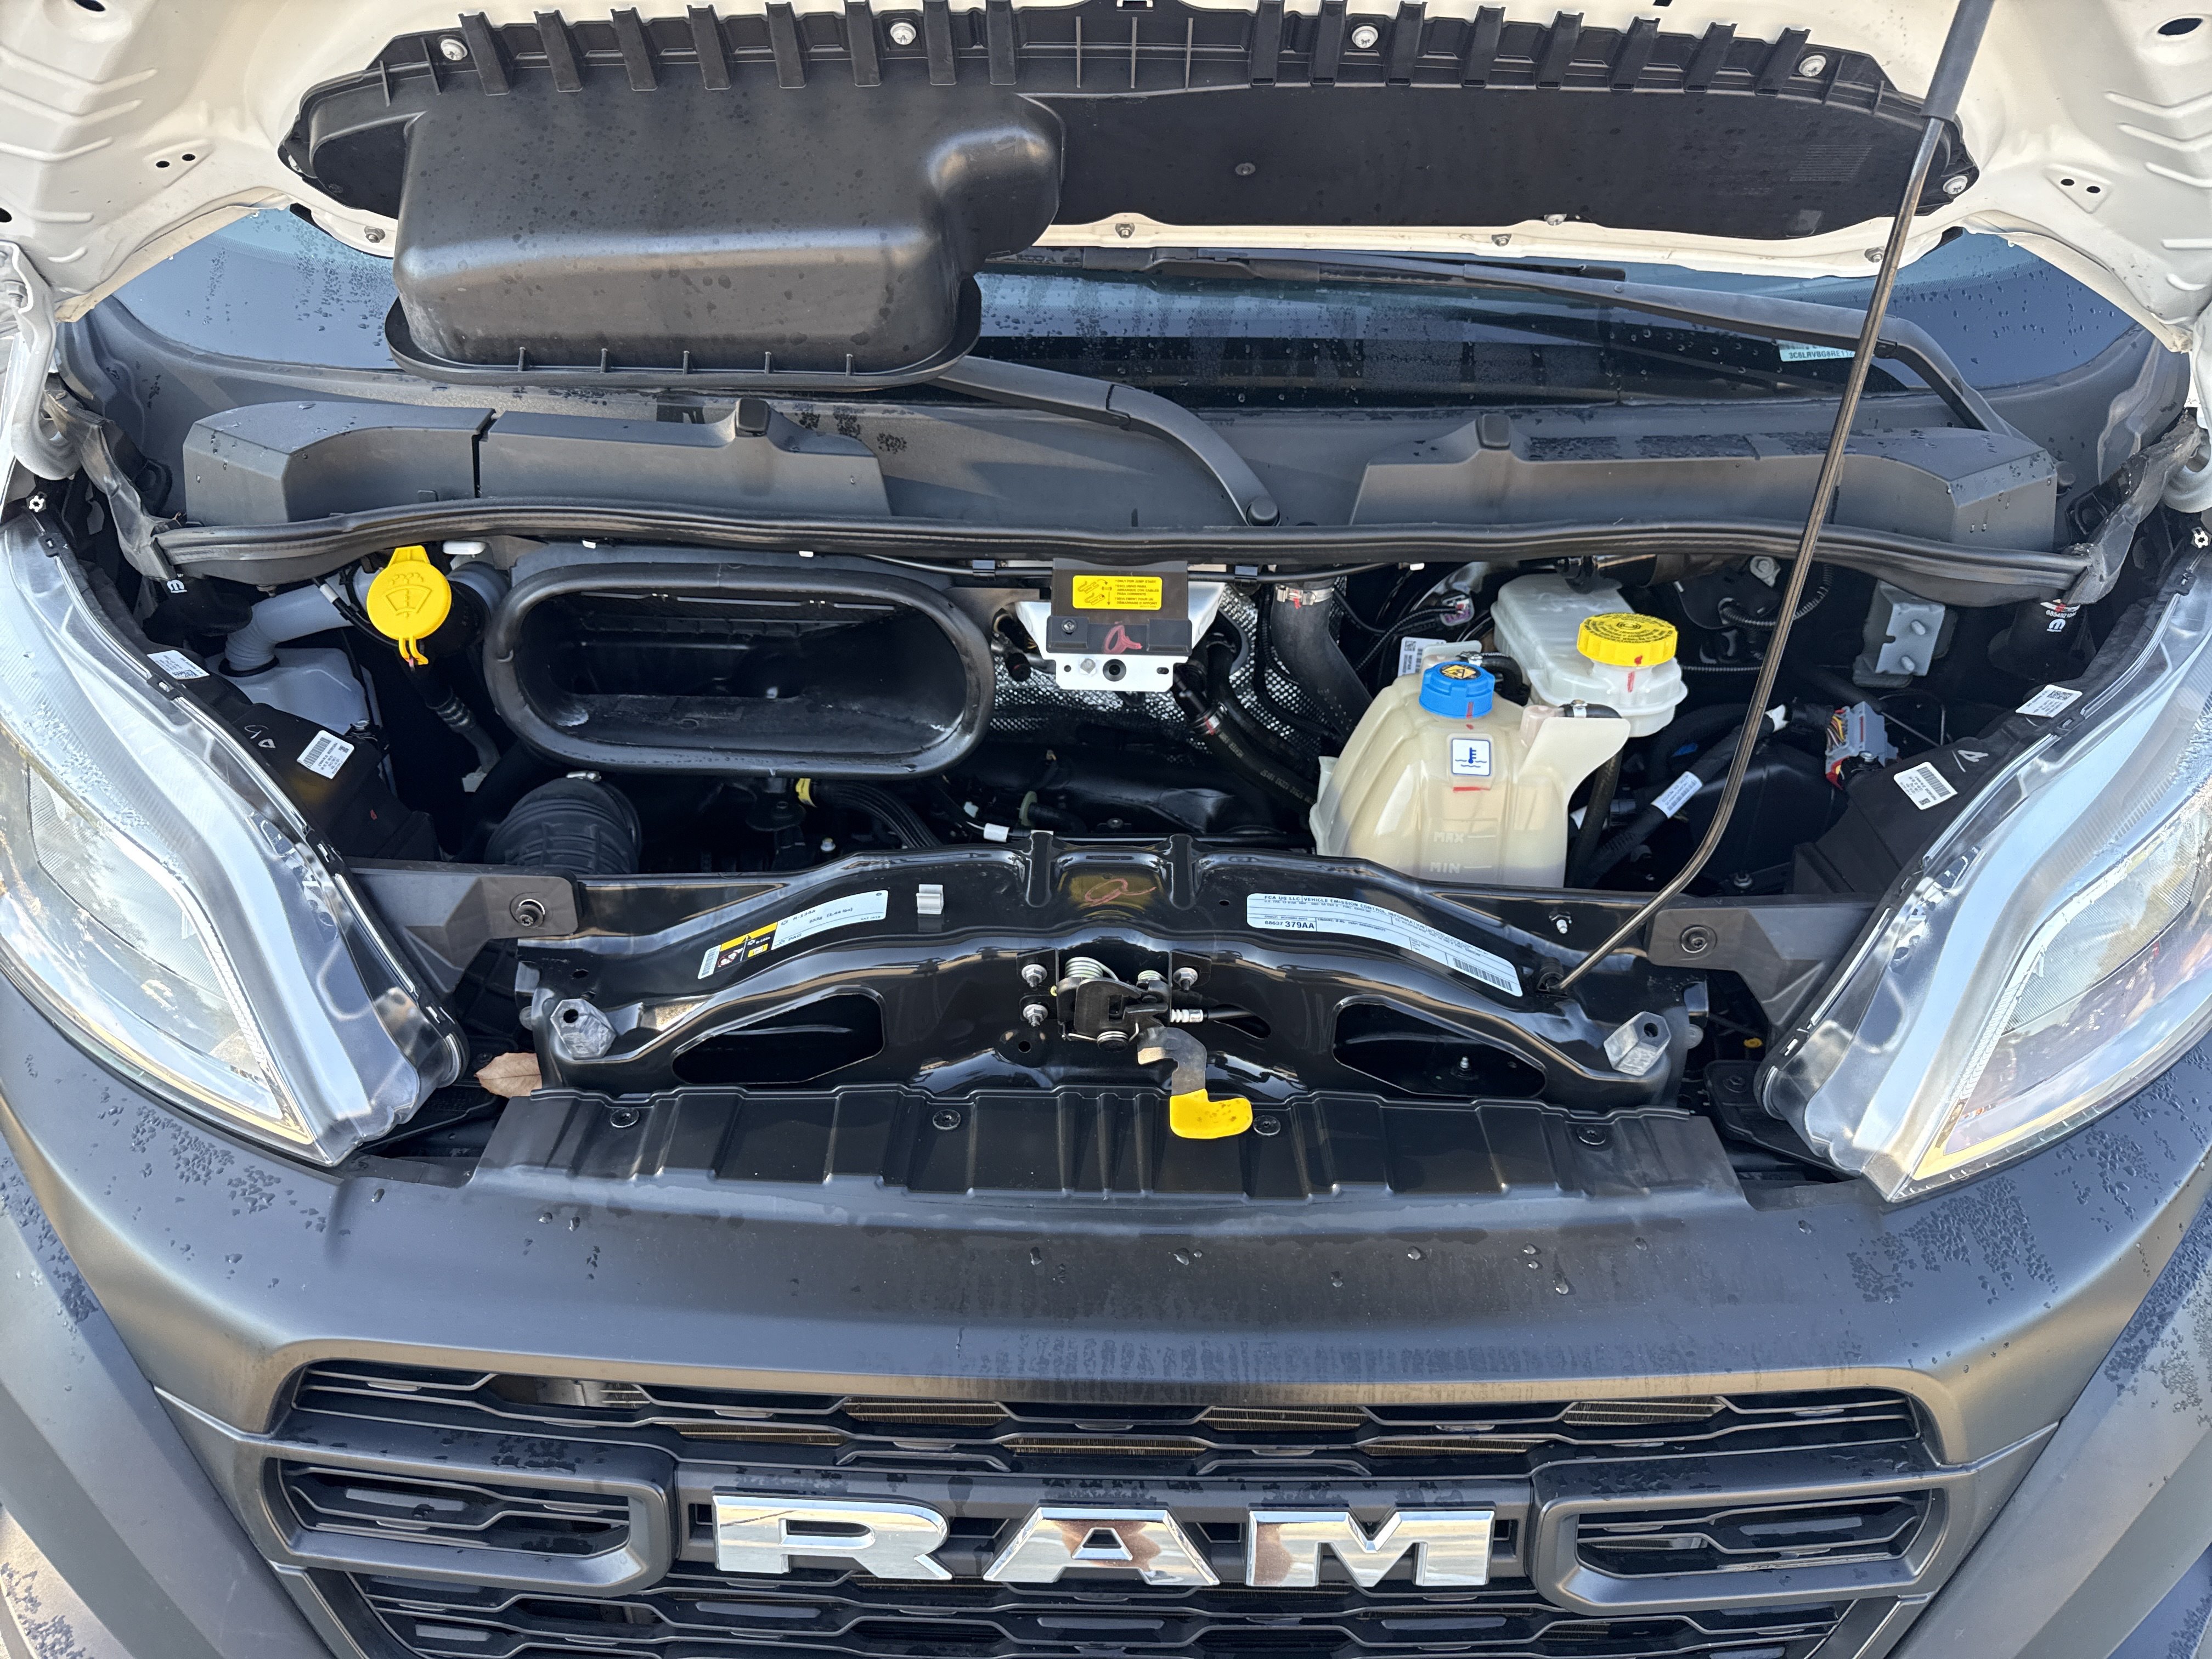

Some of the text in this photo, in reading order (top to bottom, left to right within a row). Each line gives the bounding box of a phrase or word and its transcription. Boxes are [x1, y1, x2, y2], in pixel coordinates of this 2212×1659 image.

[1434, 832, 1464, 843] MAX
[1430, 862, 1462, 873] MIN
[1360, 904, 1386, 914] CONTROL
[1388, 911, 1425, 929] INFORMATION
[788, 933, 802, 941] PAG
[712, 1494, 1496, 1588] RAM
